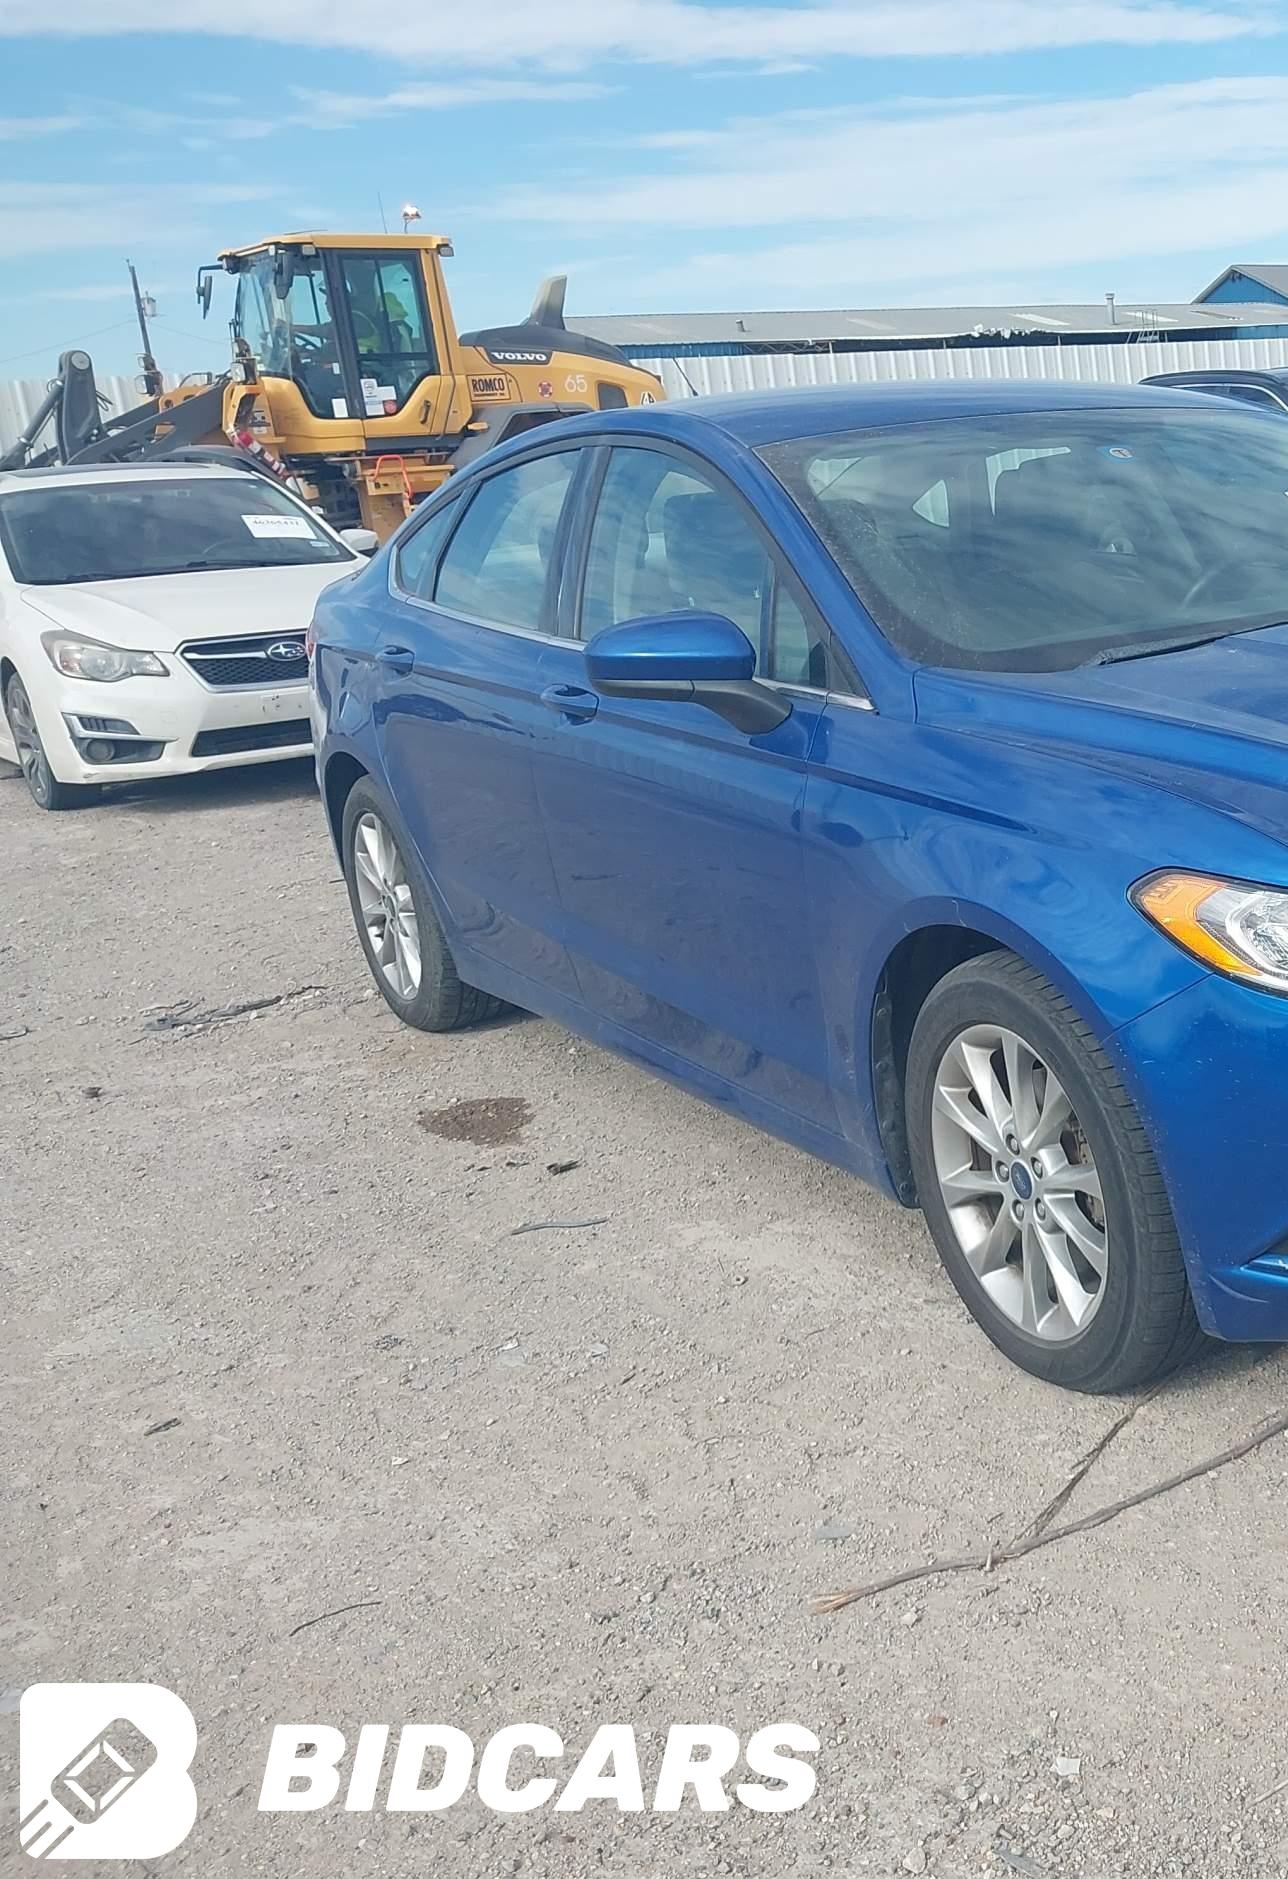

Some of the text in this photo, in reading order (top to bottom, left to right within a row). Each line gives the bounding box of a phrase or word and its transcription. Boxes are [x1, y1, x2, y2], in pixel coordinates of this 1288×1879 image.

[490, 352, 548, 362] VOLVO
[472, 378, 505, 393] ROMCO
[564, 374, 588, 393] 65
